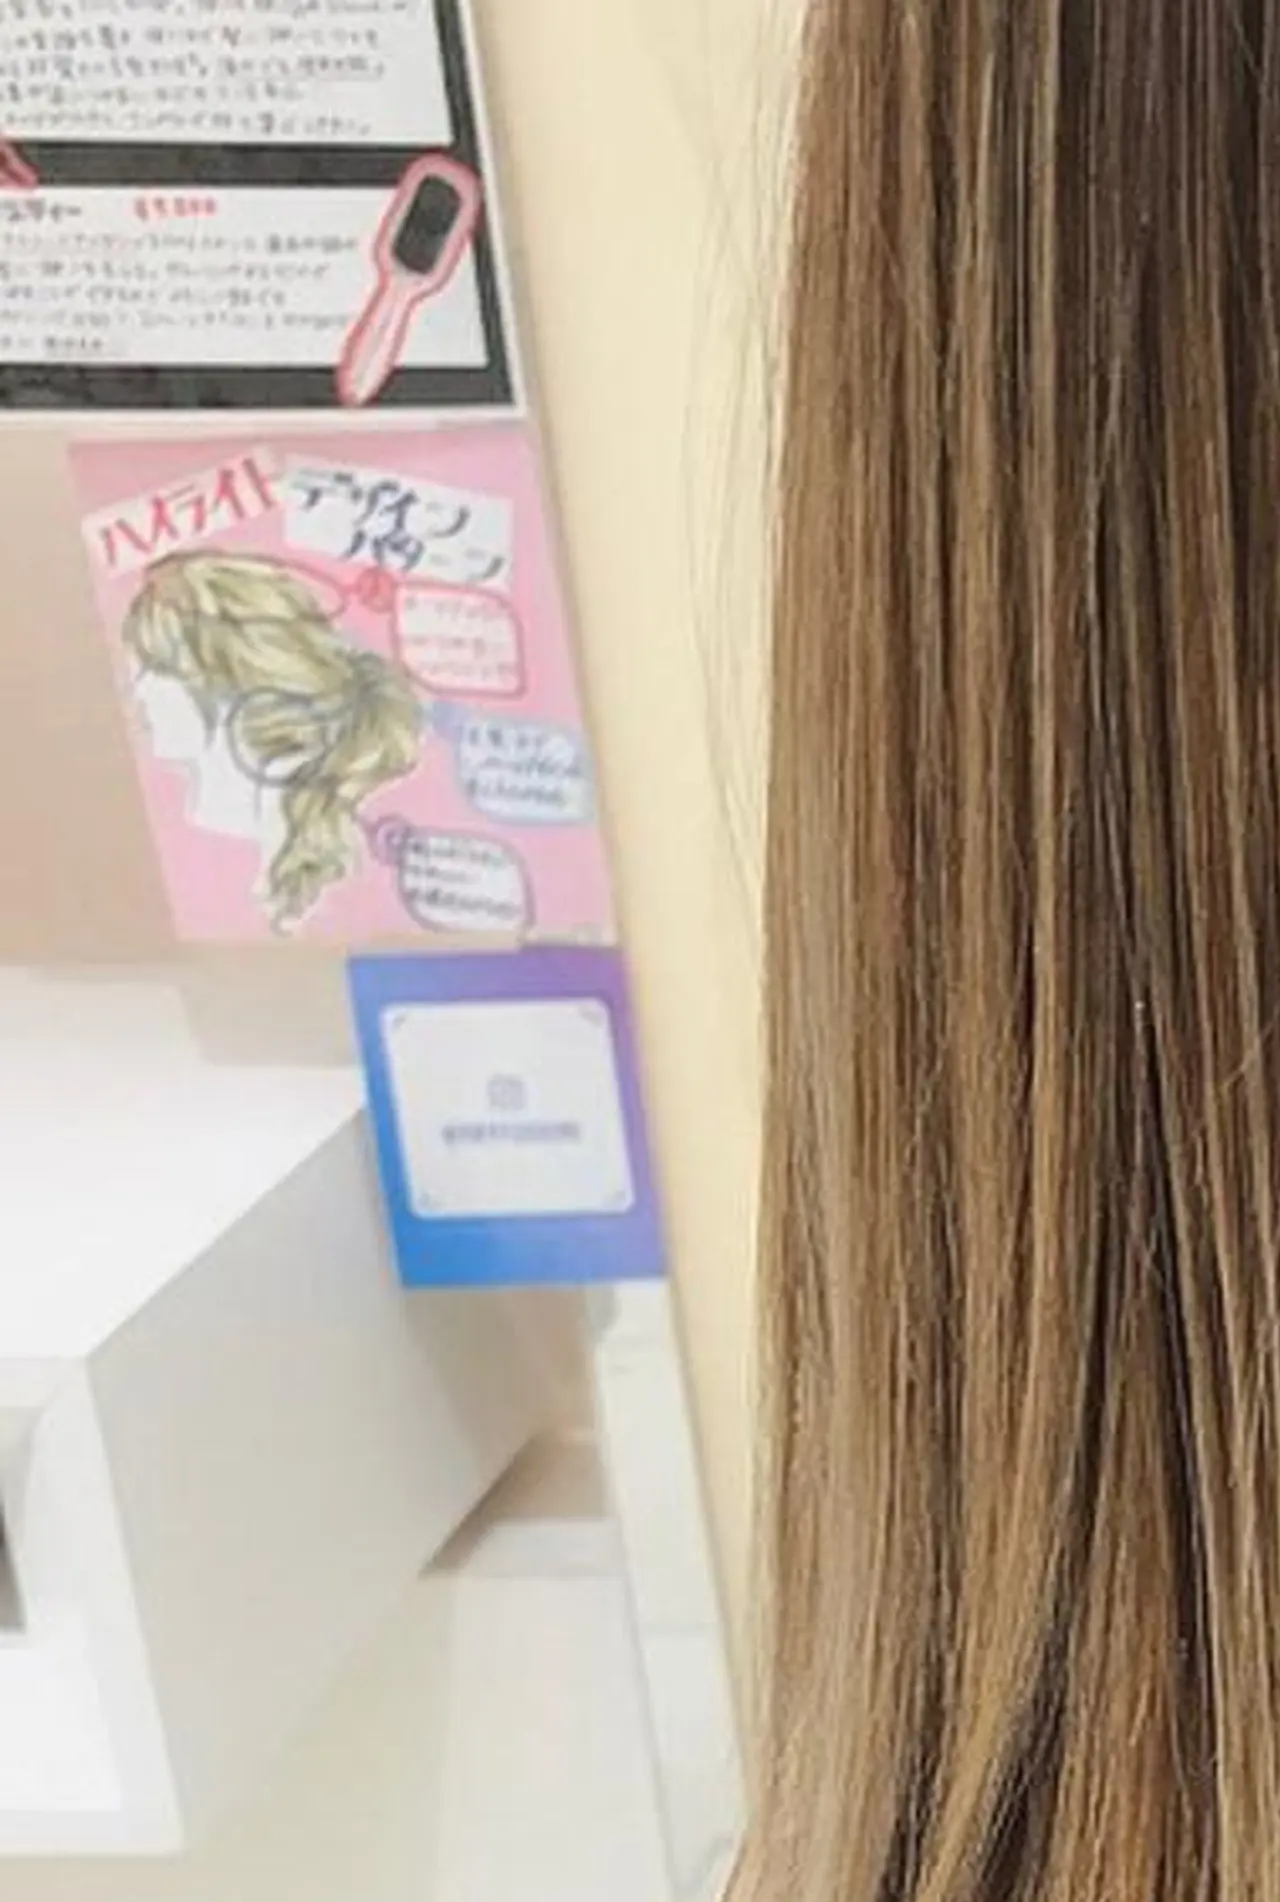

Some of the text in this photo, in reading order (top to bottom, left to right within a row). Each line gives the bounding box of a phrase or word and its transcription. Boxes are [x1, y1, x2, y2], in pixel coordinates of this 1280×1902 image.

[100, 457, 276, 567] ハイライト
